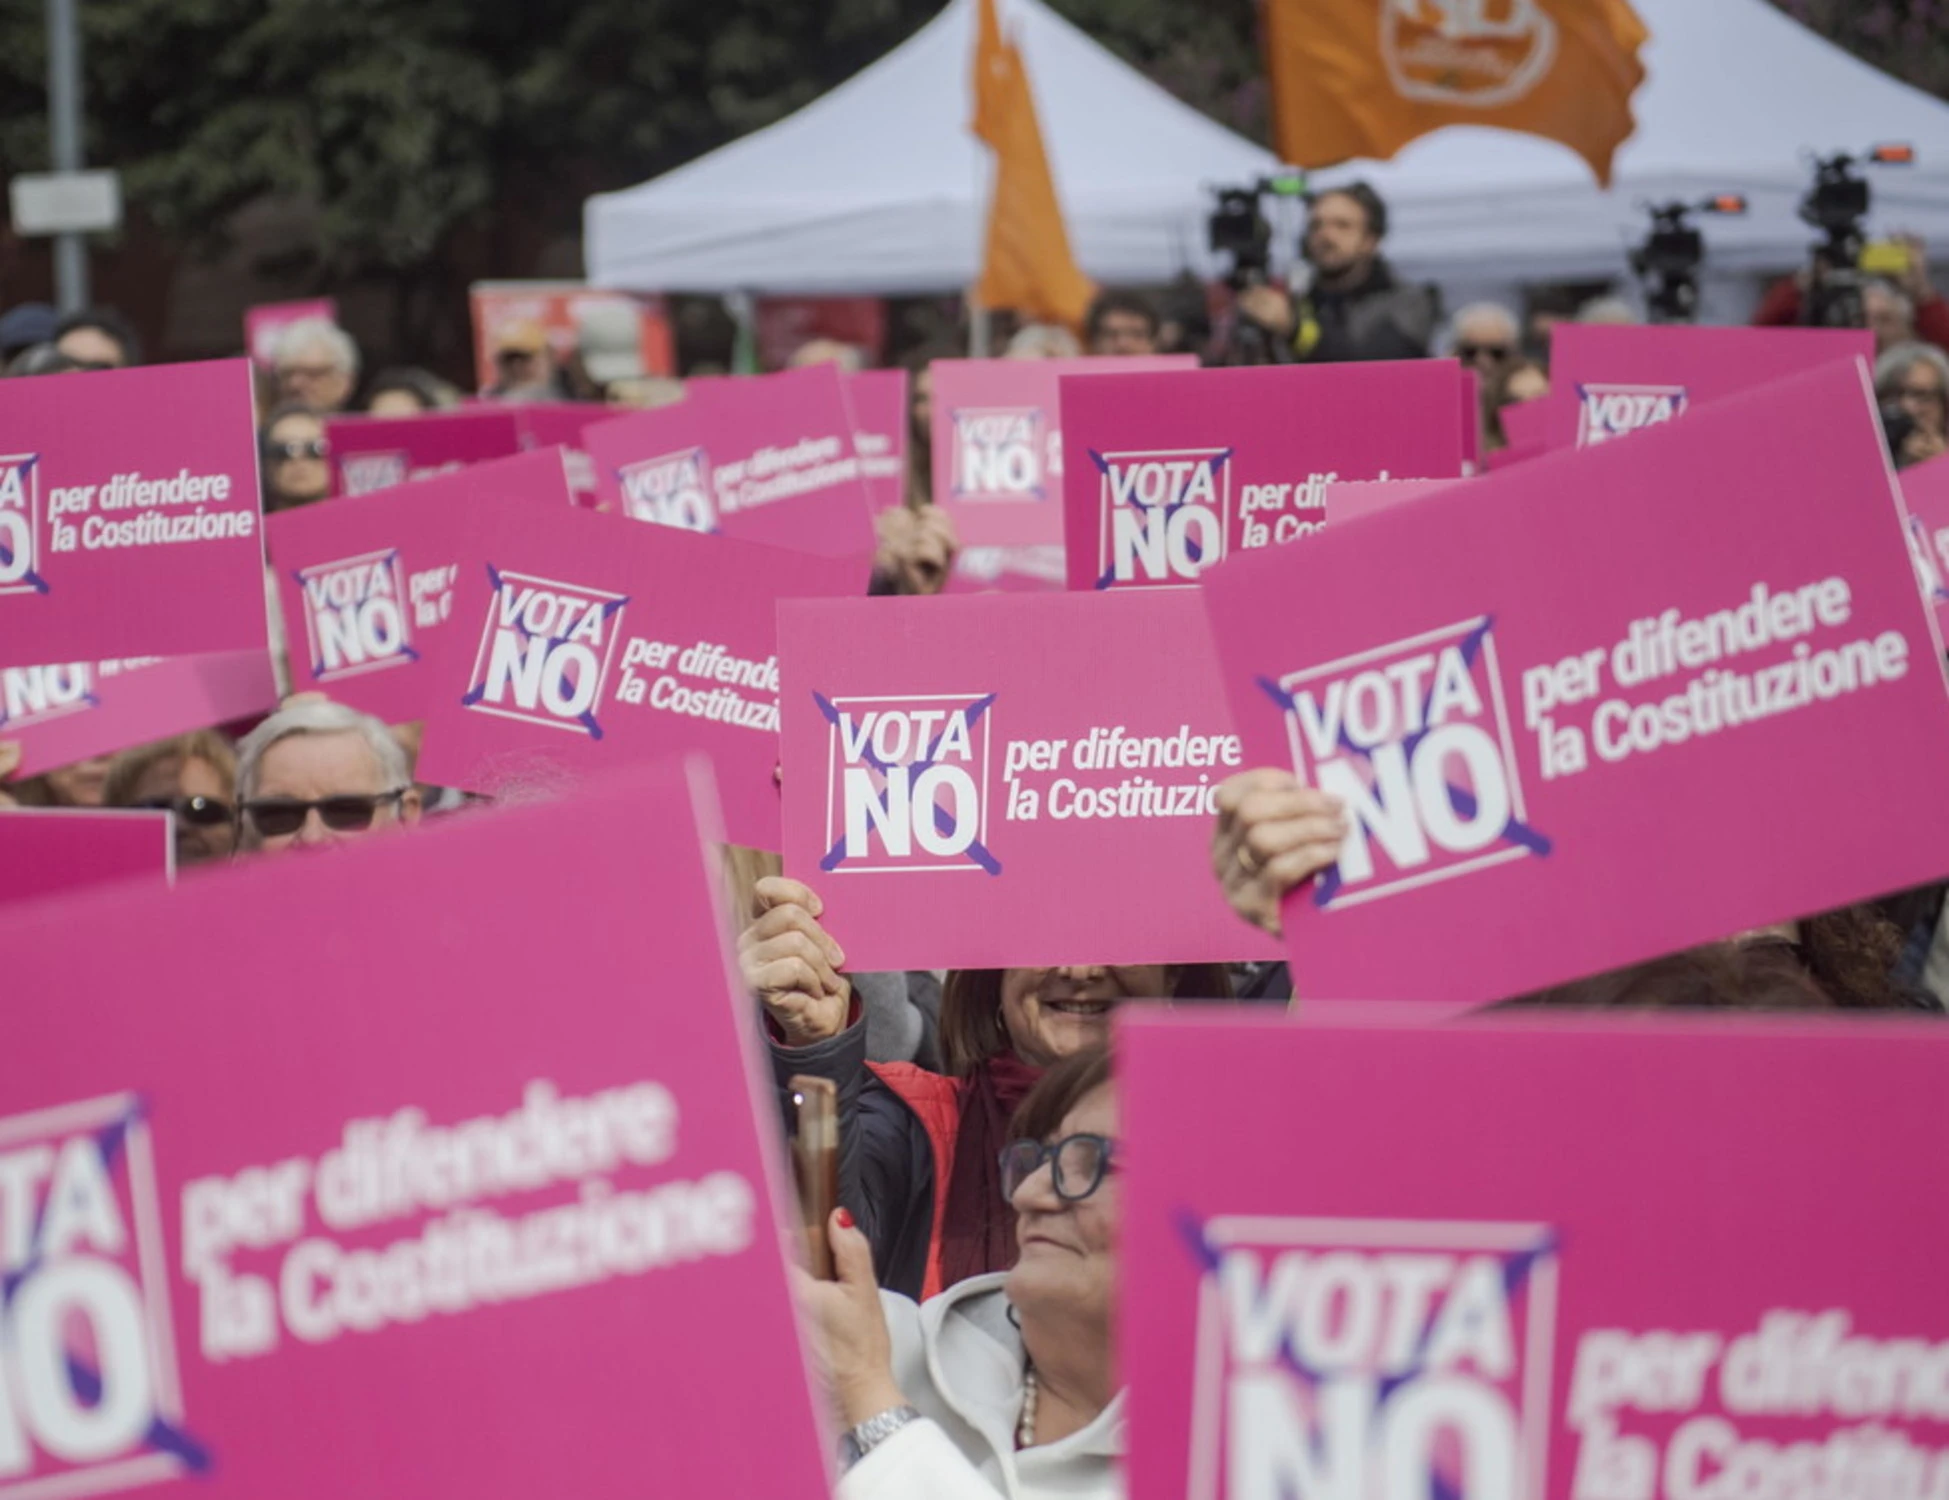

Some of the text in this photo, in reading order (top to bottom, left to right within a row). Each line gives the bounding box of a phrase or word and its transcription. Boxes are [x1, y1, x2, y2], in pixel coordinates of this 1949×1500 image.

[1588, 394, 1672, 426] VOTA
[48, 485, 97, 524] per
[99, 468, 231, 510] difendere
[963, 443, 1038, 491] NO
[1108, 461, 1216, 506] VOTA
[51, 506, 255, 553] la Costituzione
[1239, 483, 1292, 520] per
[1241, 514, 1269, 549] la
[1113, 504, 1221, 580] NO
[306, 561, 391, 611] VOTA
[410, 567, 448, 604] per
[499, 584, 605, 646] VOTA
[317, 597, 401, 668] NO
[620, 637, 779, 692] per difende
[1523, 575, 1851, 730] per difendere
[3, 662, 85, 717] NO
[484, 627, 599, 718] NO
[616, 668, 781, 733] la Costituzi
[1293, 646, 1482, 760] VOTA
[1538, 630, 1909, 780] la Costituzione
[839, 710, 973, 766] VOTA
[1004, 725, 1242, 782] per difendere
[844, 764, 979, 858] NO
[1006, 775, 1220, 821] la Costituzio
[1316, 721, 1512, 886] NO
[183, 1076, 678, 1282] per difendere
[201, 1169, 757, 1363] la Costituzione
[1218, 1246, 1517, 1376] VOTA
[0, 1256, 151, 1478] O
[1567, 1328, 1724, 1432] per
[1226, 1370, 1519, 1500] NO
[1571, 1410, 1658, 1500] la
